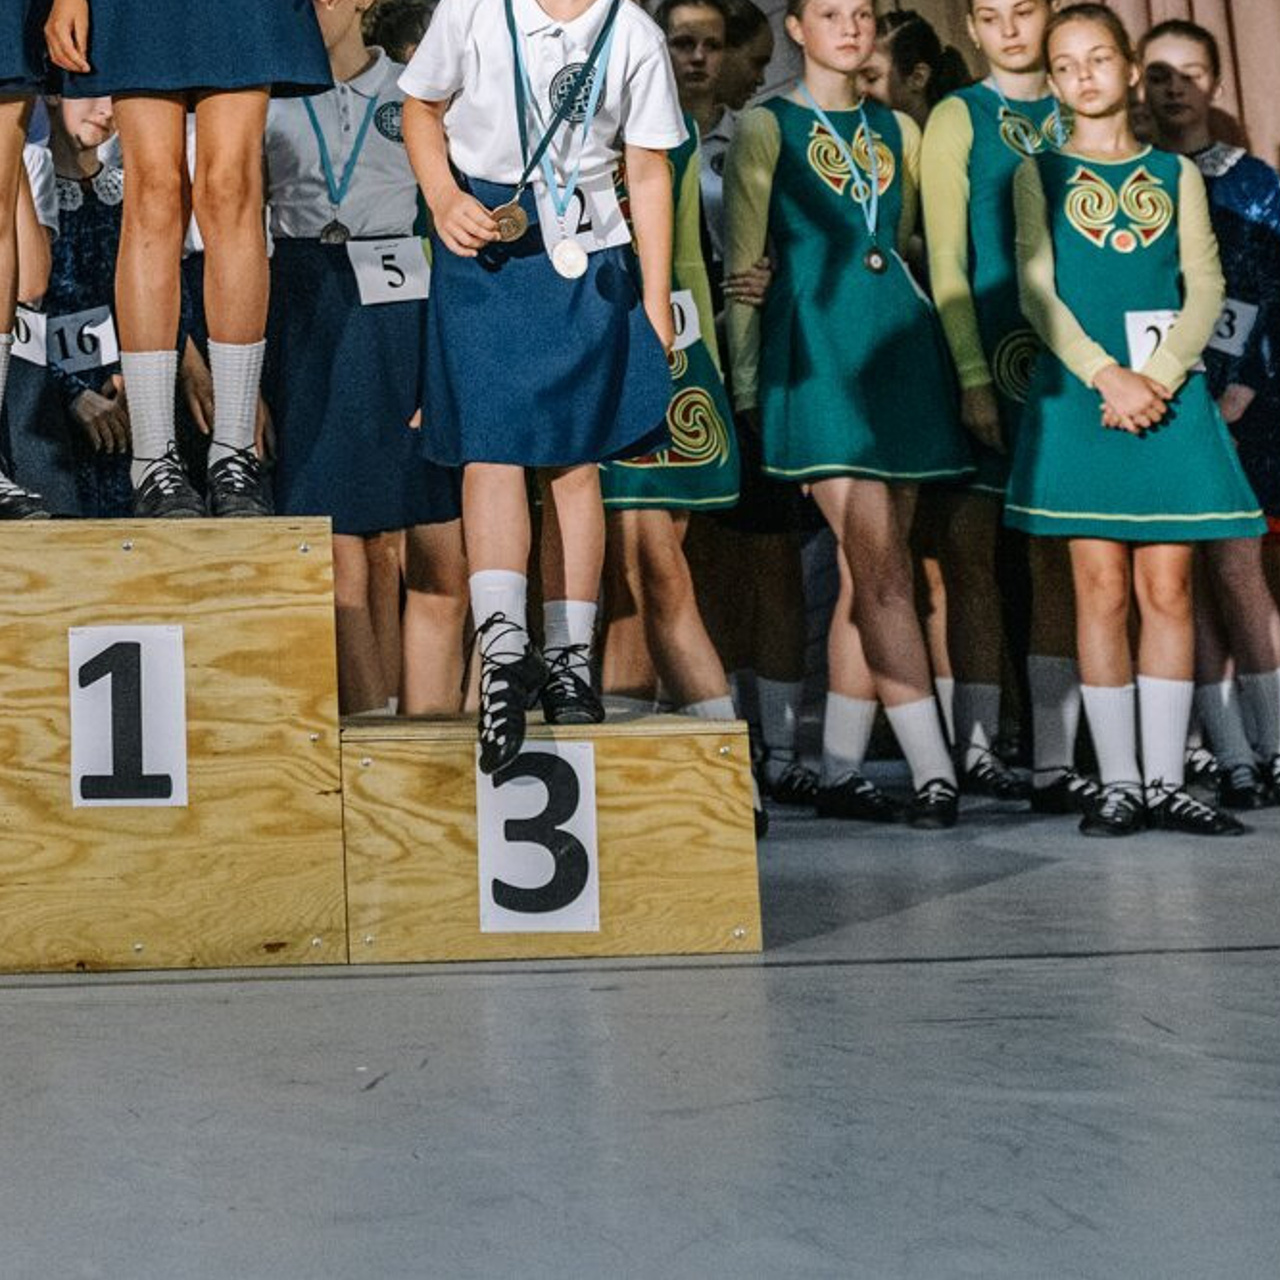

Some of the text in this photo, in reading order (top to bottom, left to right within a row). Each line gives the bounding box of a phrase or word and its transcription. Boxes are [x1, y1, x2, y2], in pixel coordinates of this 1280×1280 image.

[381, 254, 406, 289] 5
[53, 319, 101, 361] 16
[1216, 308, 1237, 339] 3
[78, 641, 173, 800] 1
[491, 751, 590, 914] 3
